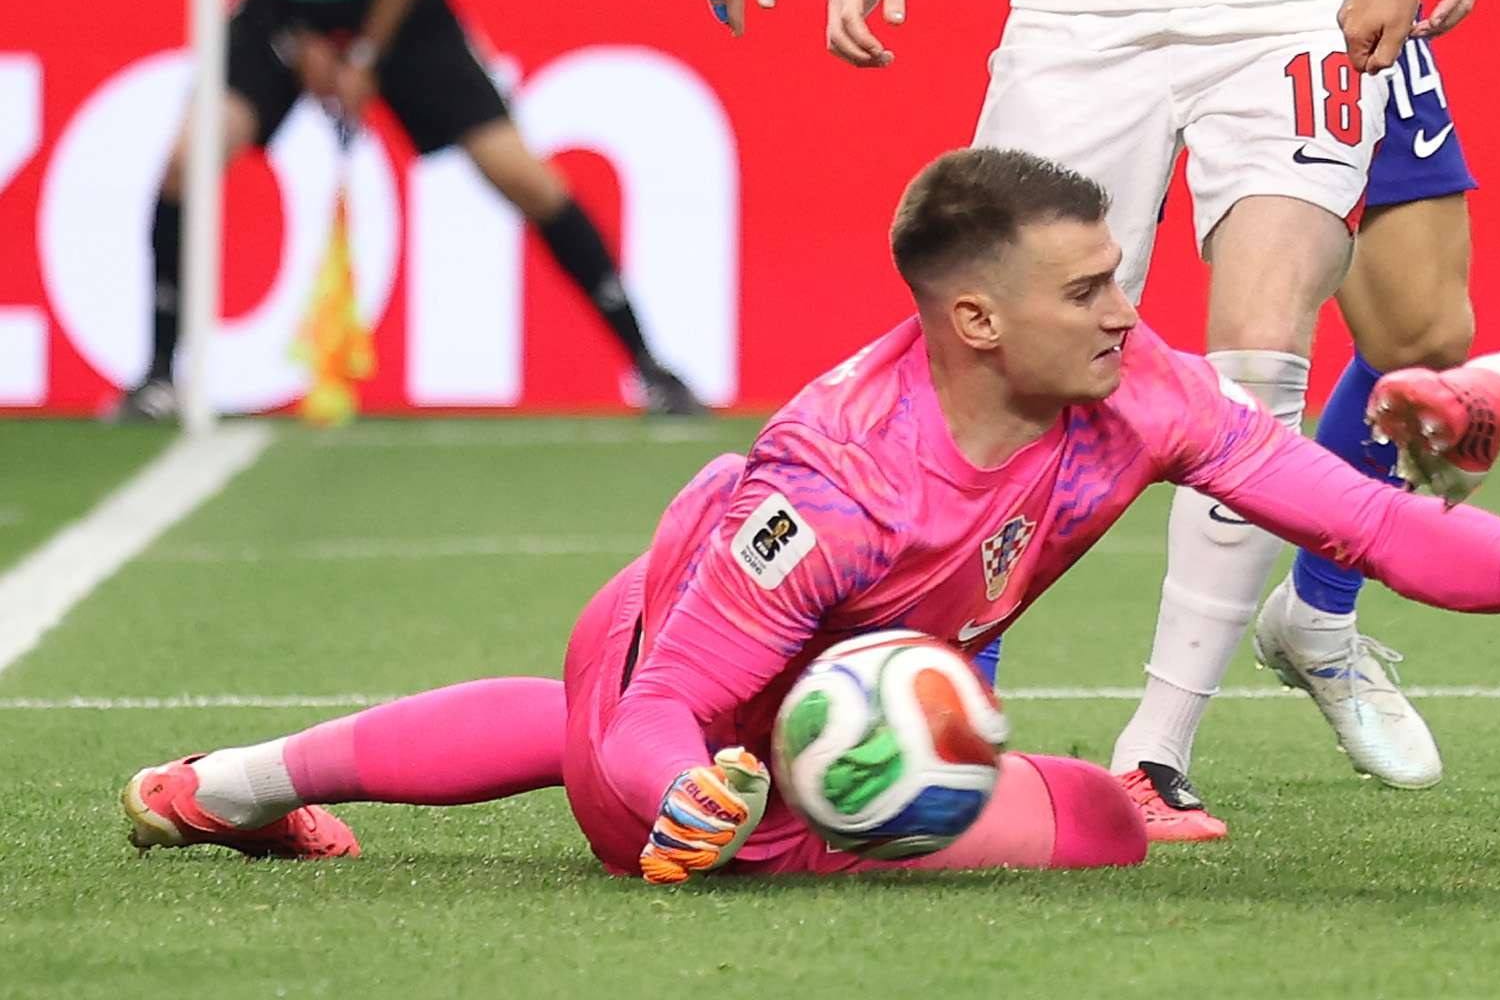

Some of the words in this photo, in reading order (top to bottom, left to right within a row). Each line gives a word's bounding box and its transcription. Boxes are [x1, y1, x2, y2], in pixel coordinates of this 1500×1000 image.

[1284, 50, 1362, 148] 18
[1391, 38, 1447, 119] 14
[0, 43, 742, 414] on
